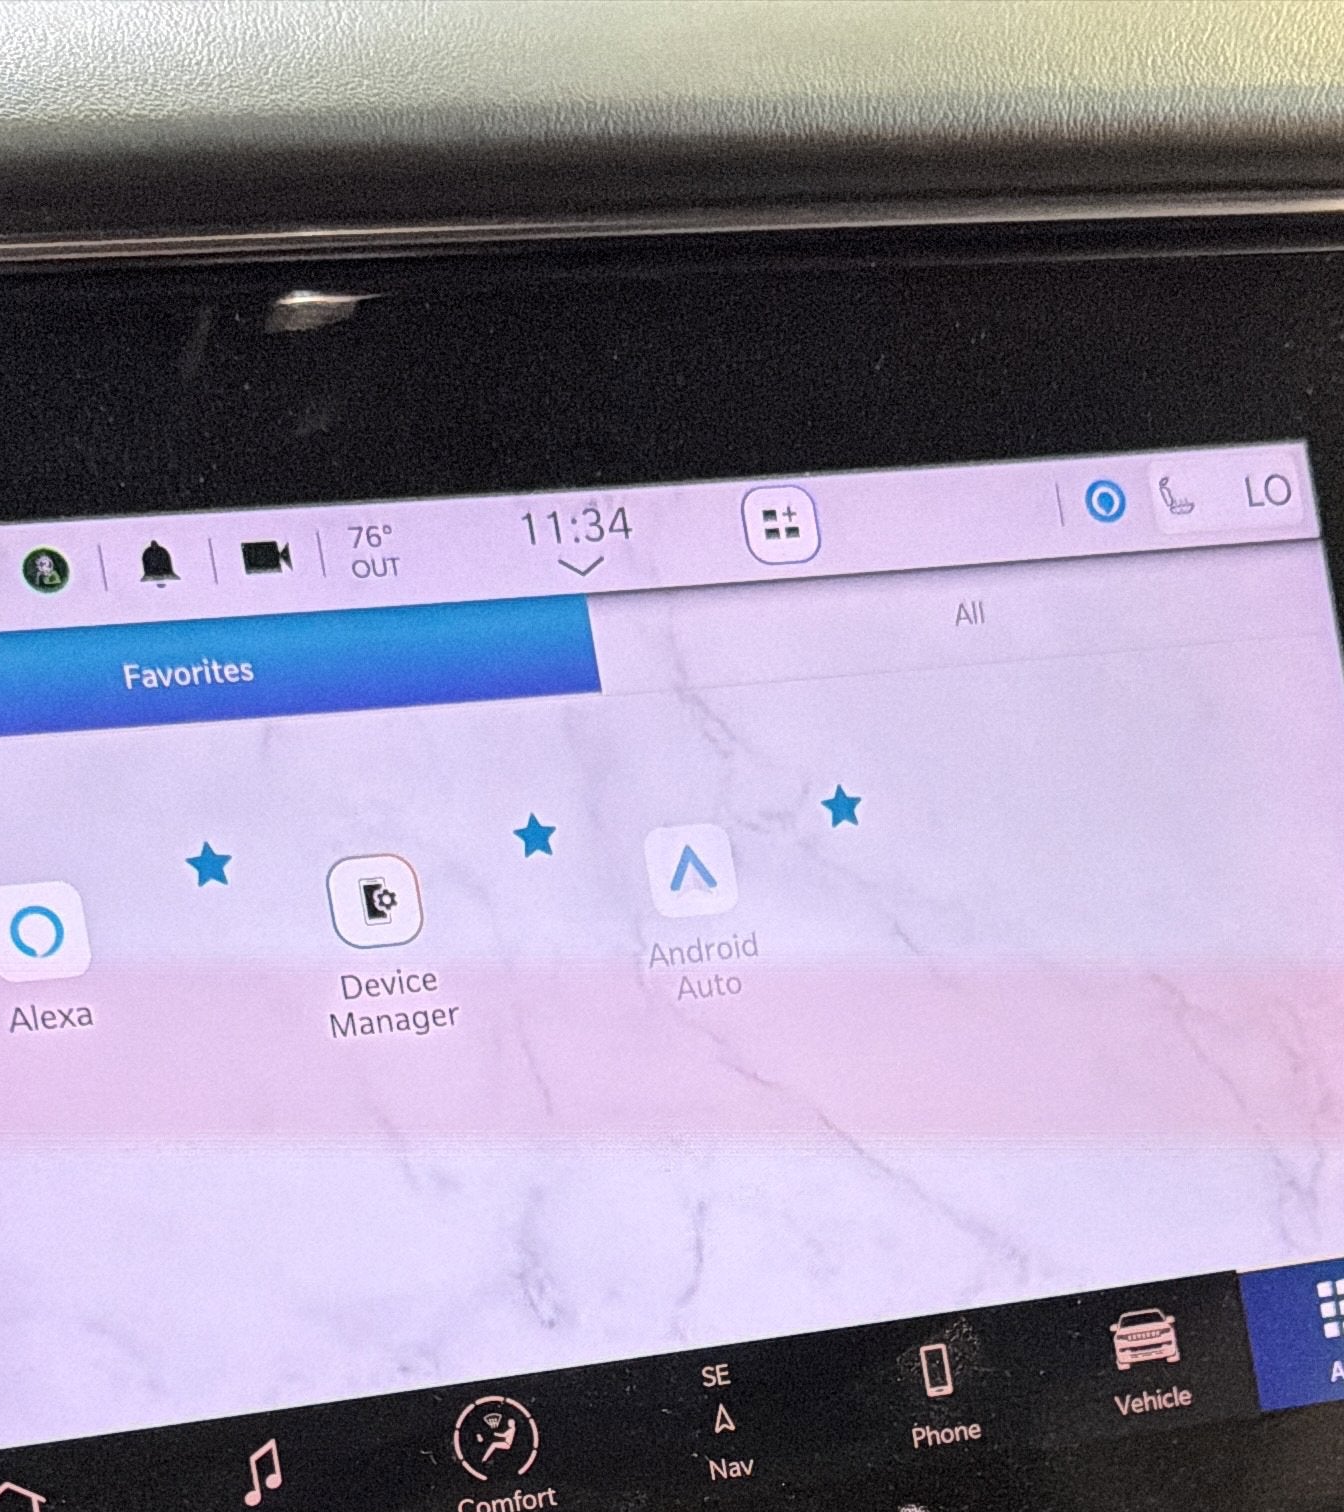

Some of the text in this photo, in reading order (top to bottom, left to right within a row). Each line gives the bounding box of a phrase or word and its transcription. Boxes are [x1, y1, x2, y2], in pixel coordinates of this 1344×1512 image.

[1244, 473, 1293, 508] LO
[521, 506, 633, 546] 11:34
[351, 556, 401, 579] OUT
[954, 600, 986, 627] All
[123, 657, 255, 690] Favorites
[648, 932, 760, 969] Android
[340, 968, 439, 1001] Device
[676, 973, 744, 1001] Auto
[8, 1003, 95, 1034] Alexa
[329, 1002, 460, 1039] Manager
[701, 1363, 732, 1387] SE
[1113, 1385, 1194, 1417] Vehicle
[910, 1420, 983, 1449] Phone
[708, 1456, 755, 1481] Nav
